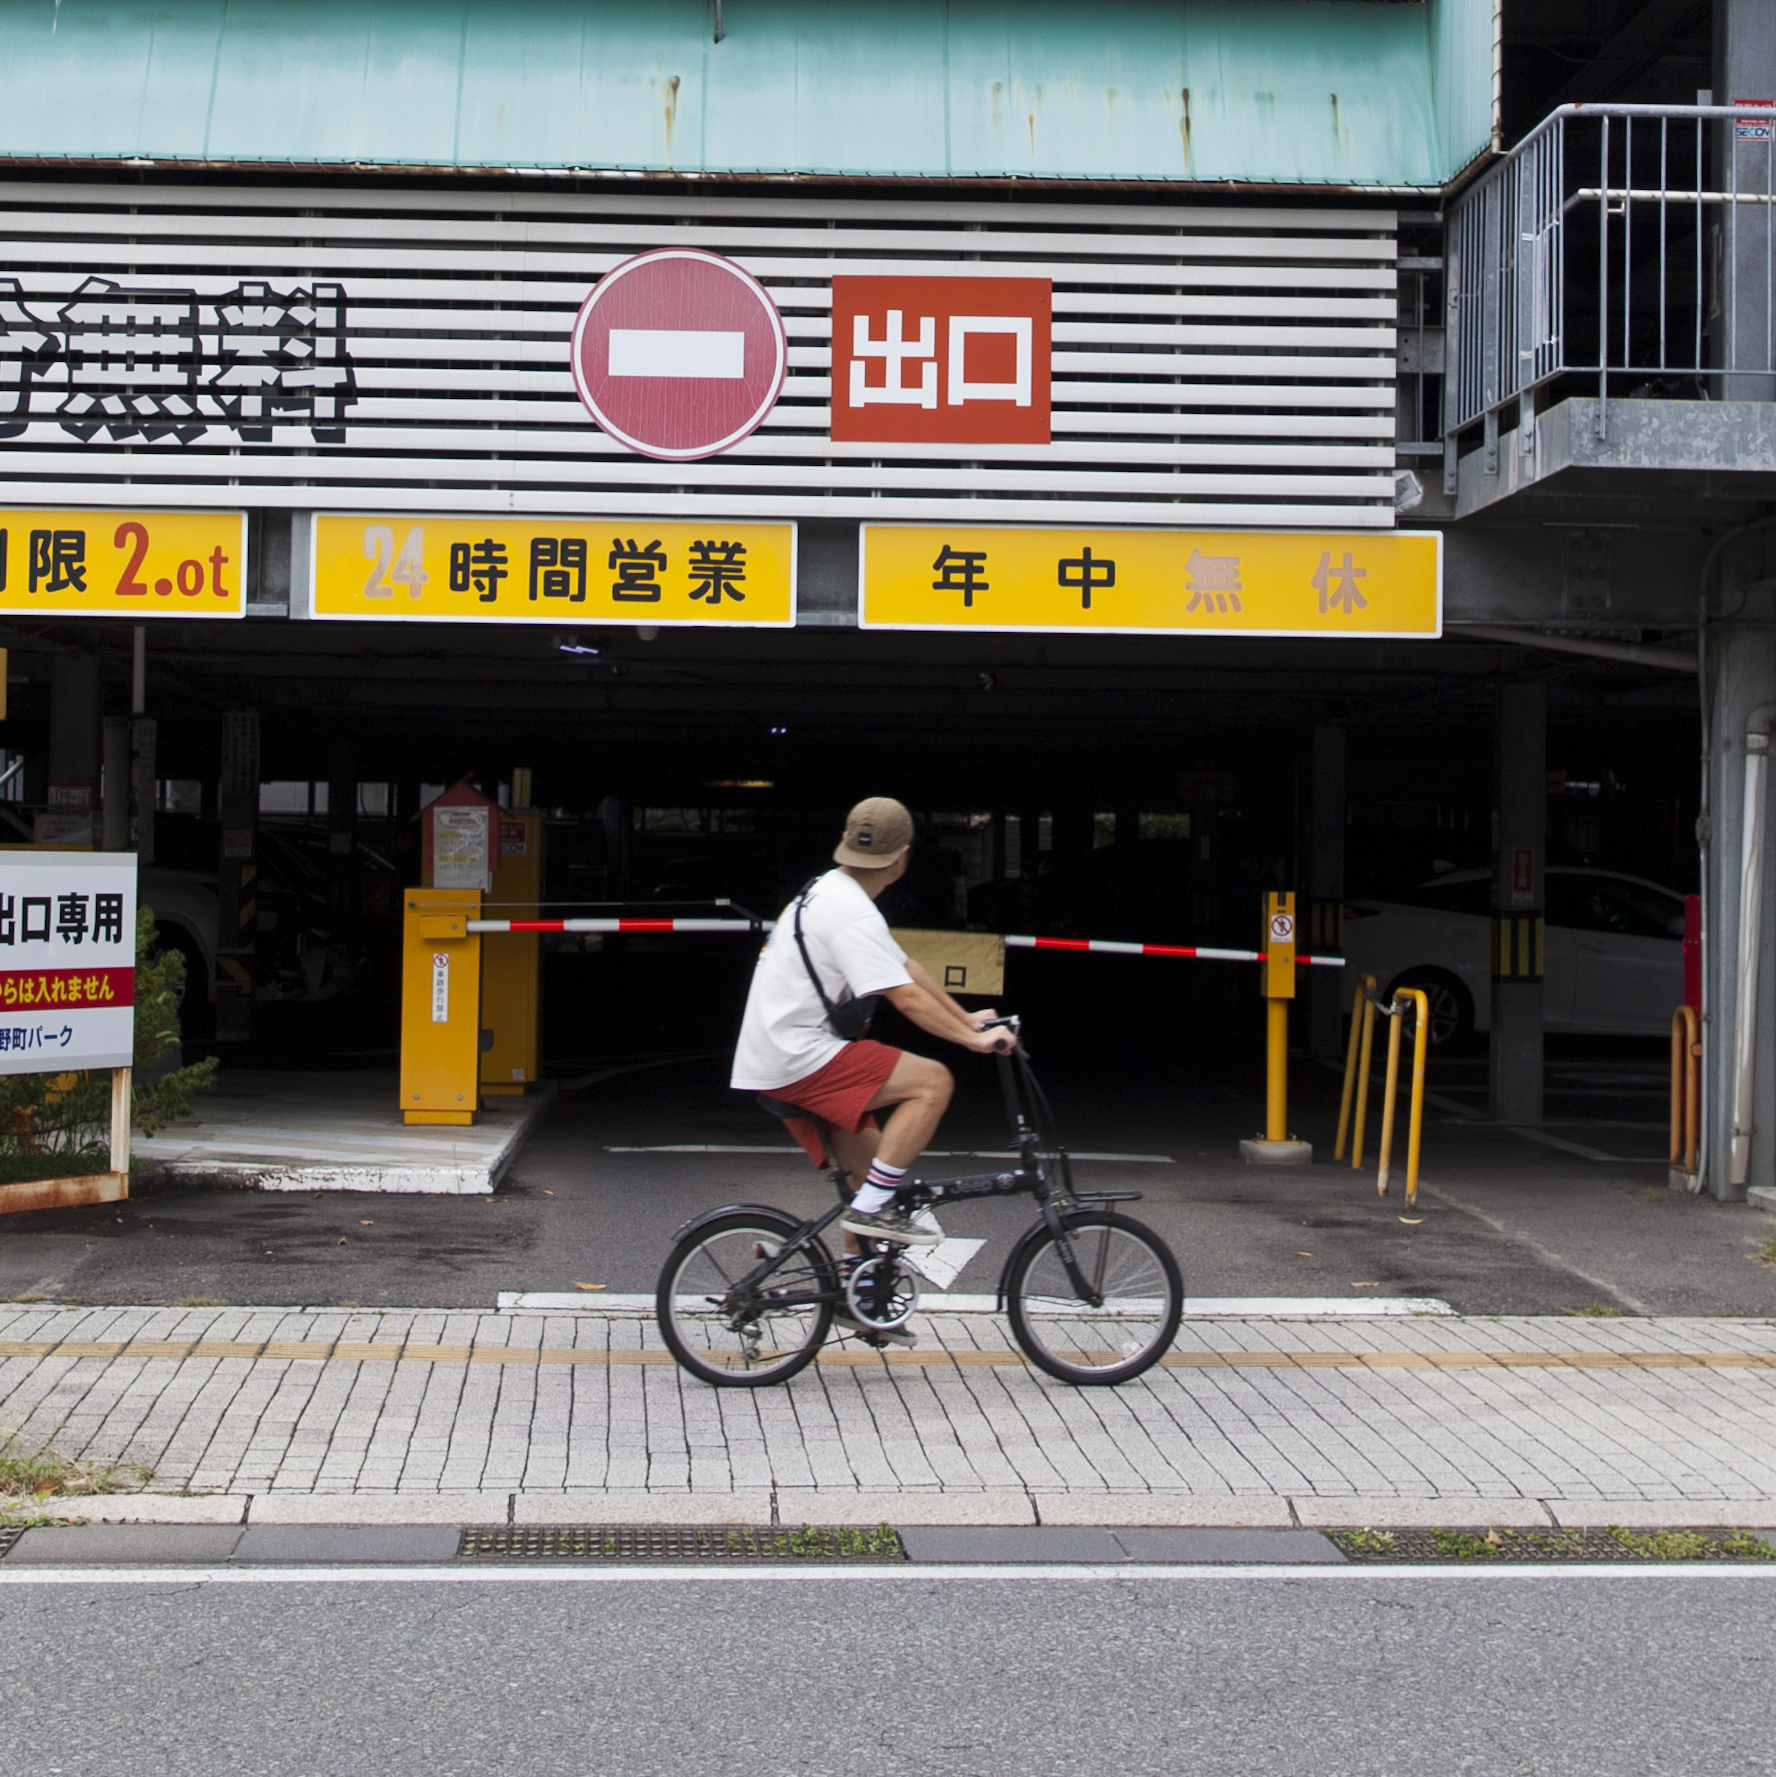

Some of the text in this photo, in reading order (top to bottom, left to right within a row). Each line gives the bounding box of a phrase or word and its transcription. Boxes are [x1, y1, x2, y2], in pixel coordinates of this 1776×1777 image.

[848, 308, 1034, 410] 出口
[362, 524, 749, 605] 24時間営業
[932, 543, 1372, 615] 年中無休
[949, 1180, 994, 1195] Jeep
